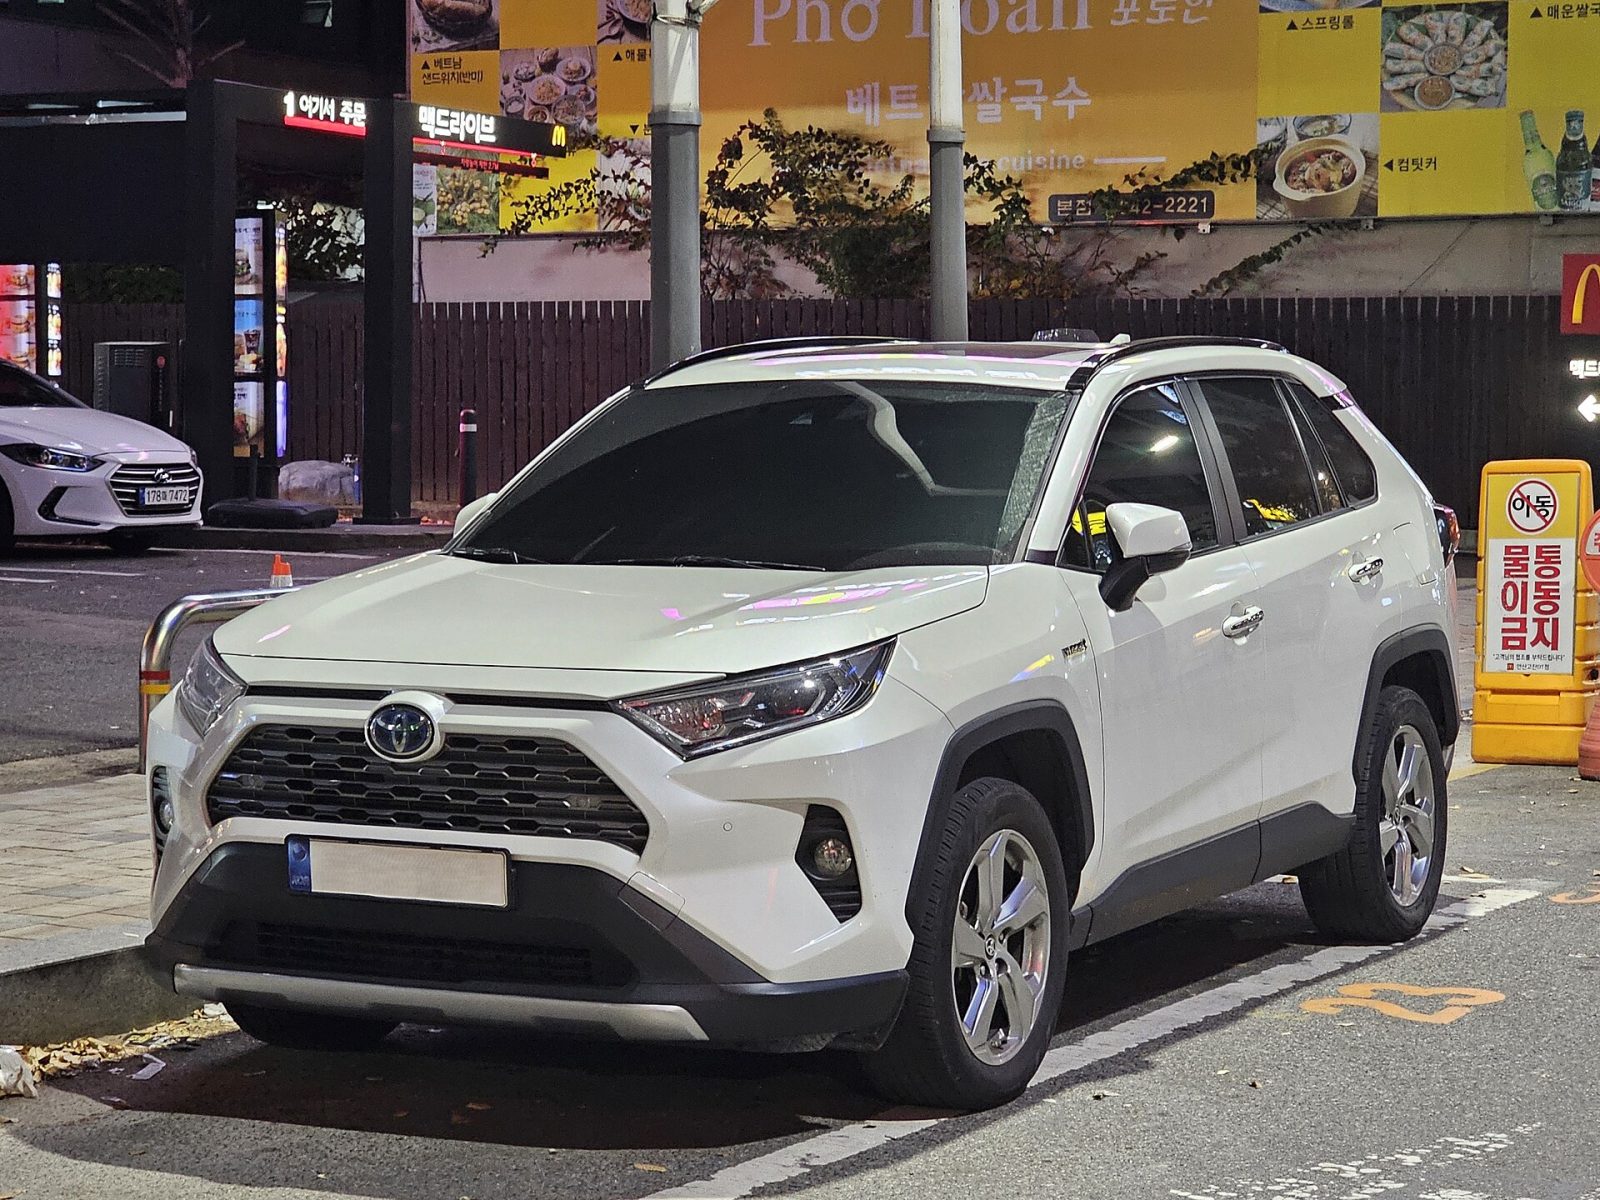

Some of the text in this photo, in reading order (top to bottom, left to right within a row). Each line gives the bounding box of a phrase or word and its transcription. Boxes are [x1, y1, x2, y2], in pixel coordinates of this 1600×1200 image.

[423, 70, 483, 85] 샌드위치(반미)
[434, 56, 462, 70] 베트남
[284, 91, 367, 127] 1 여기서 주문
[968, 76, 1092, 124] 쌀국수
[419, 105, 497, 144] 맥드라이브
[1569, 359, 1600, 379] 맥드
[1512, 494, 1554, 518] 이동
[1503, 545, 1562, 580] 물통
[1501, 580, 1561, 616] 이동
[1500, 617, 1559, 651] 금지
